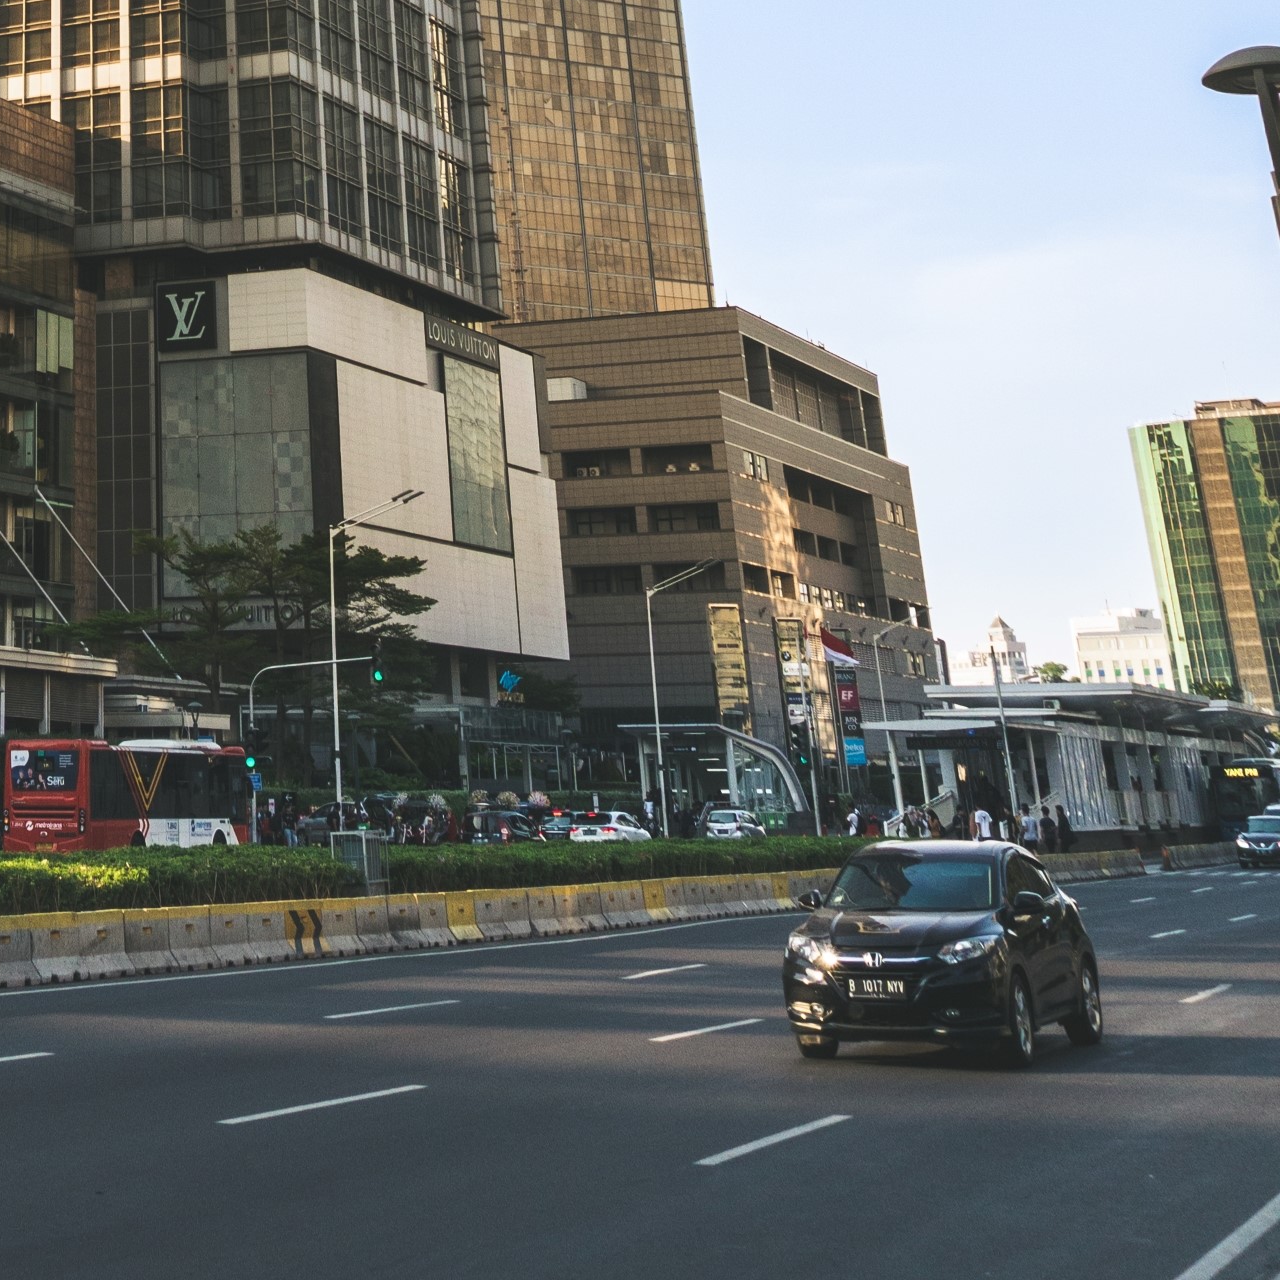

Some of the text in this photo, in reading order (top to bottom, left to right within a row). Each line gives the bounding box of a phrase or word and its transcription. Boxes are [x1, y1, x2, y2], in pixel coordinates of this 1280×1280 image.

[428, 321, 497, 361] LOUIS VUITTON
[841, 690, 854, 701] EF
[848, 978, 856, 992] B
[862, 979, 883, 993] 1017
